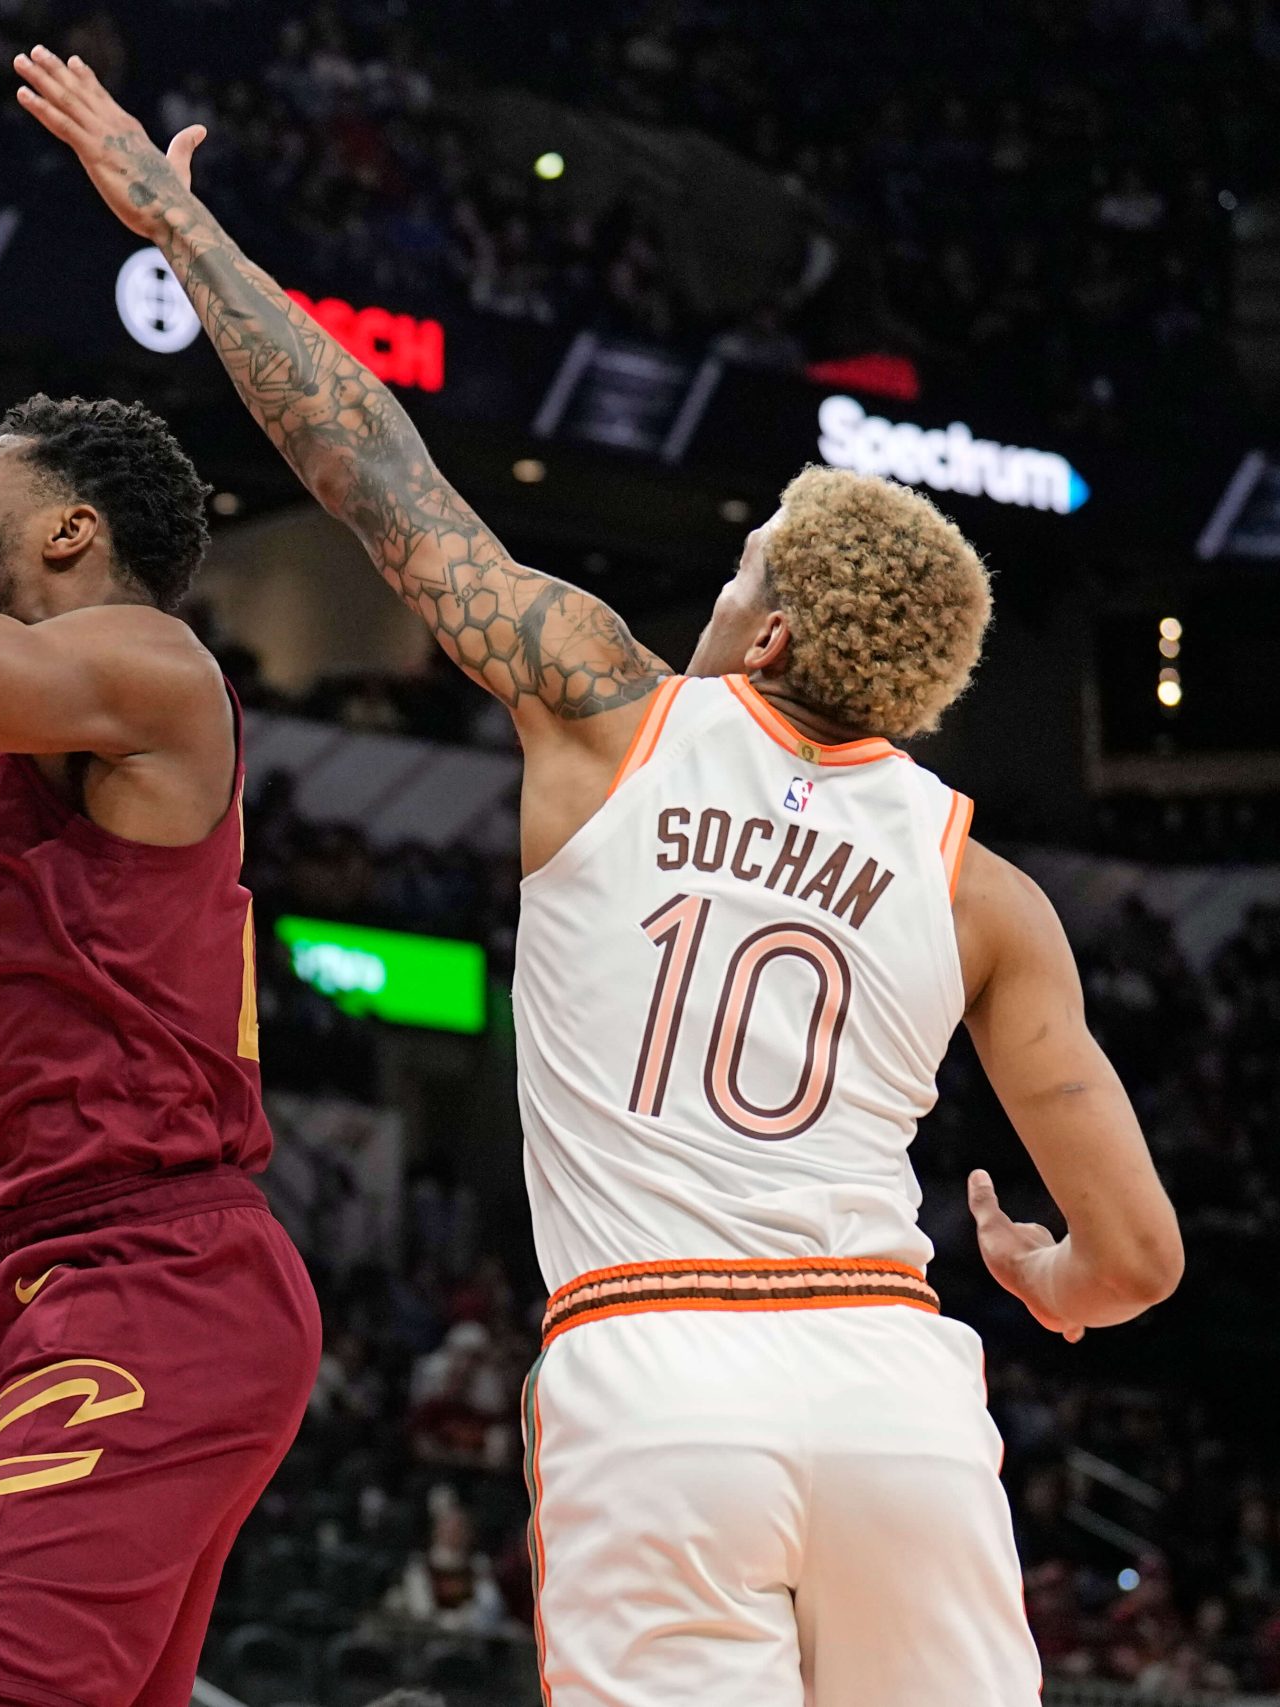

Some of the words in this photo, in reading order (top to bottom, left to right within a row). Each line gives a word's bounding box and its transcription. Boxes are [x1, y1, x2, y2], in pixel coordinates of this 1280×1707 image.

[818, 395, 1072, 515] Spectrum
[656, 807, 895, 930] SOCHAN
[628, 893, 852, 1141] 10
